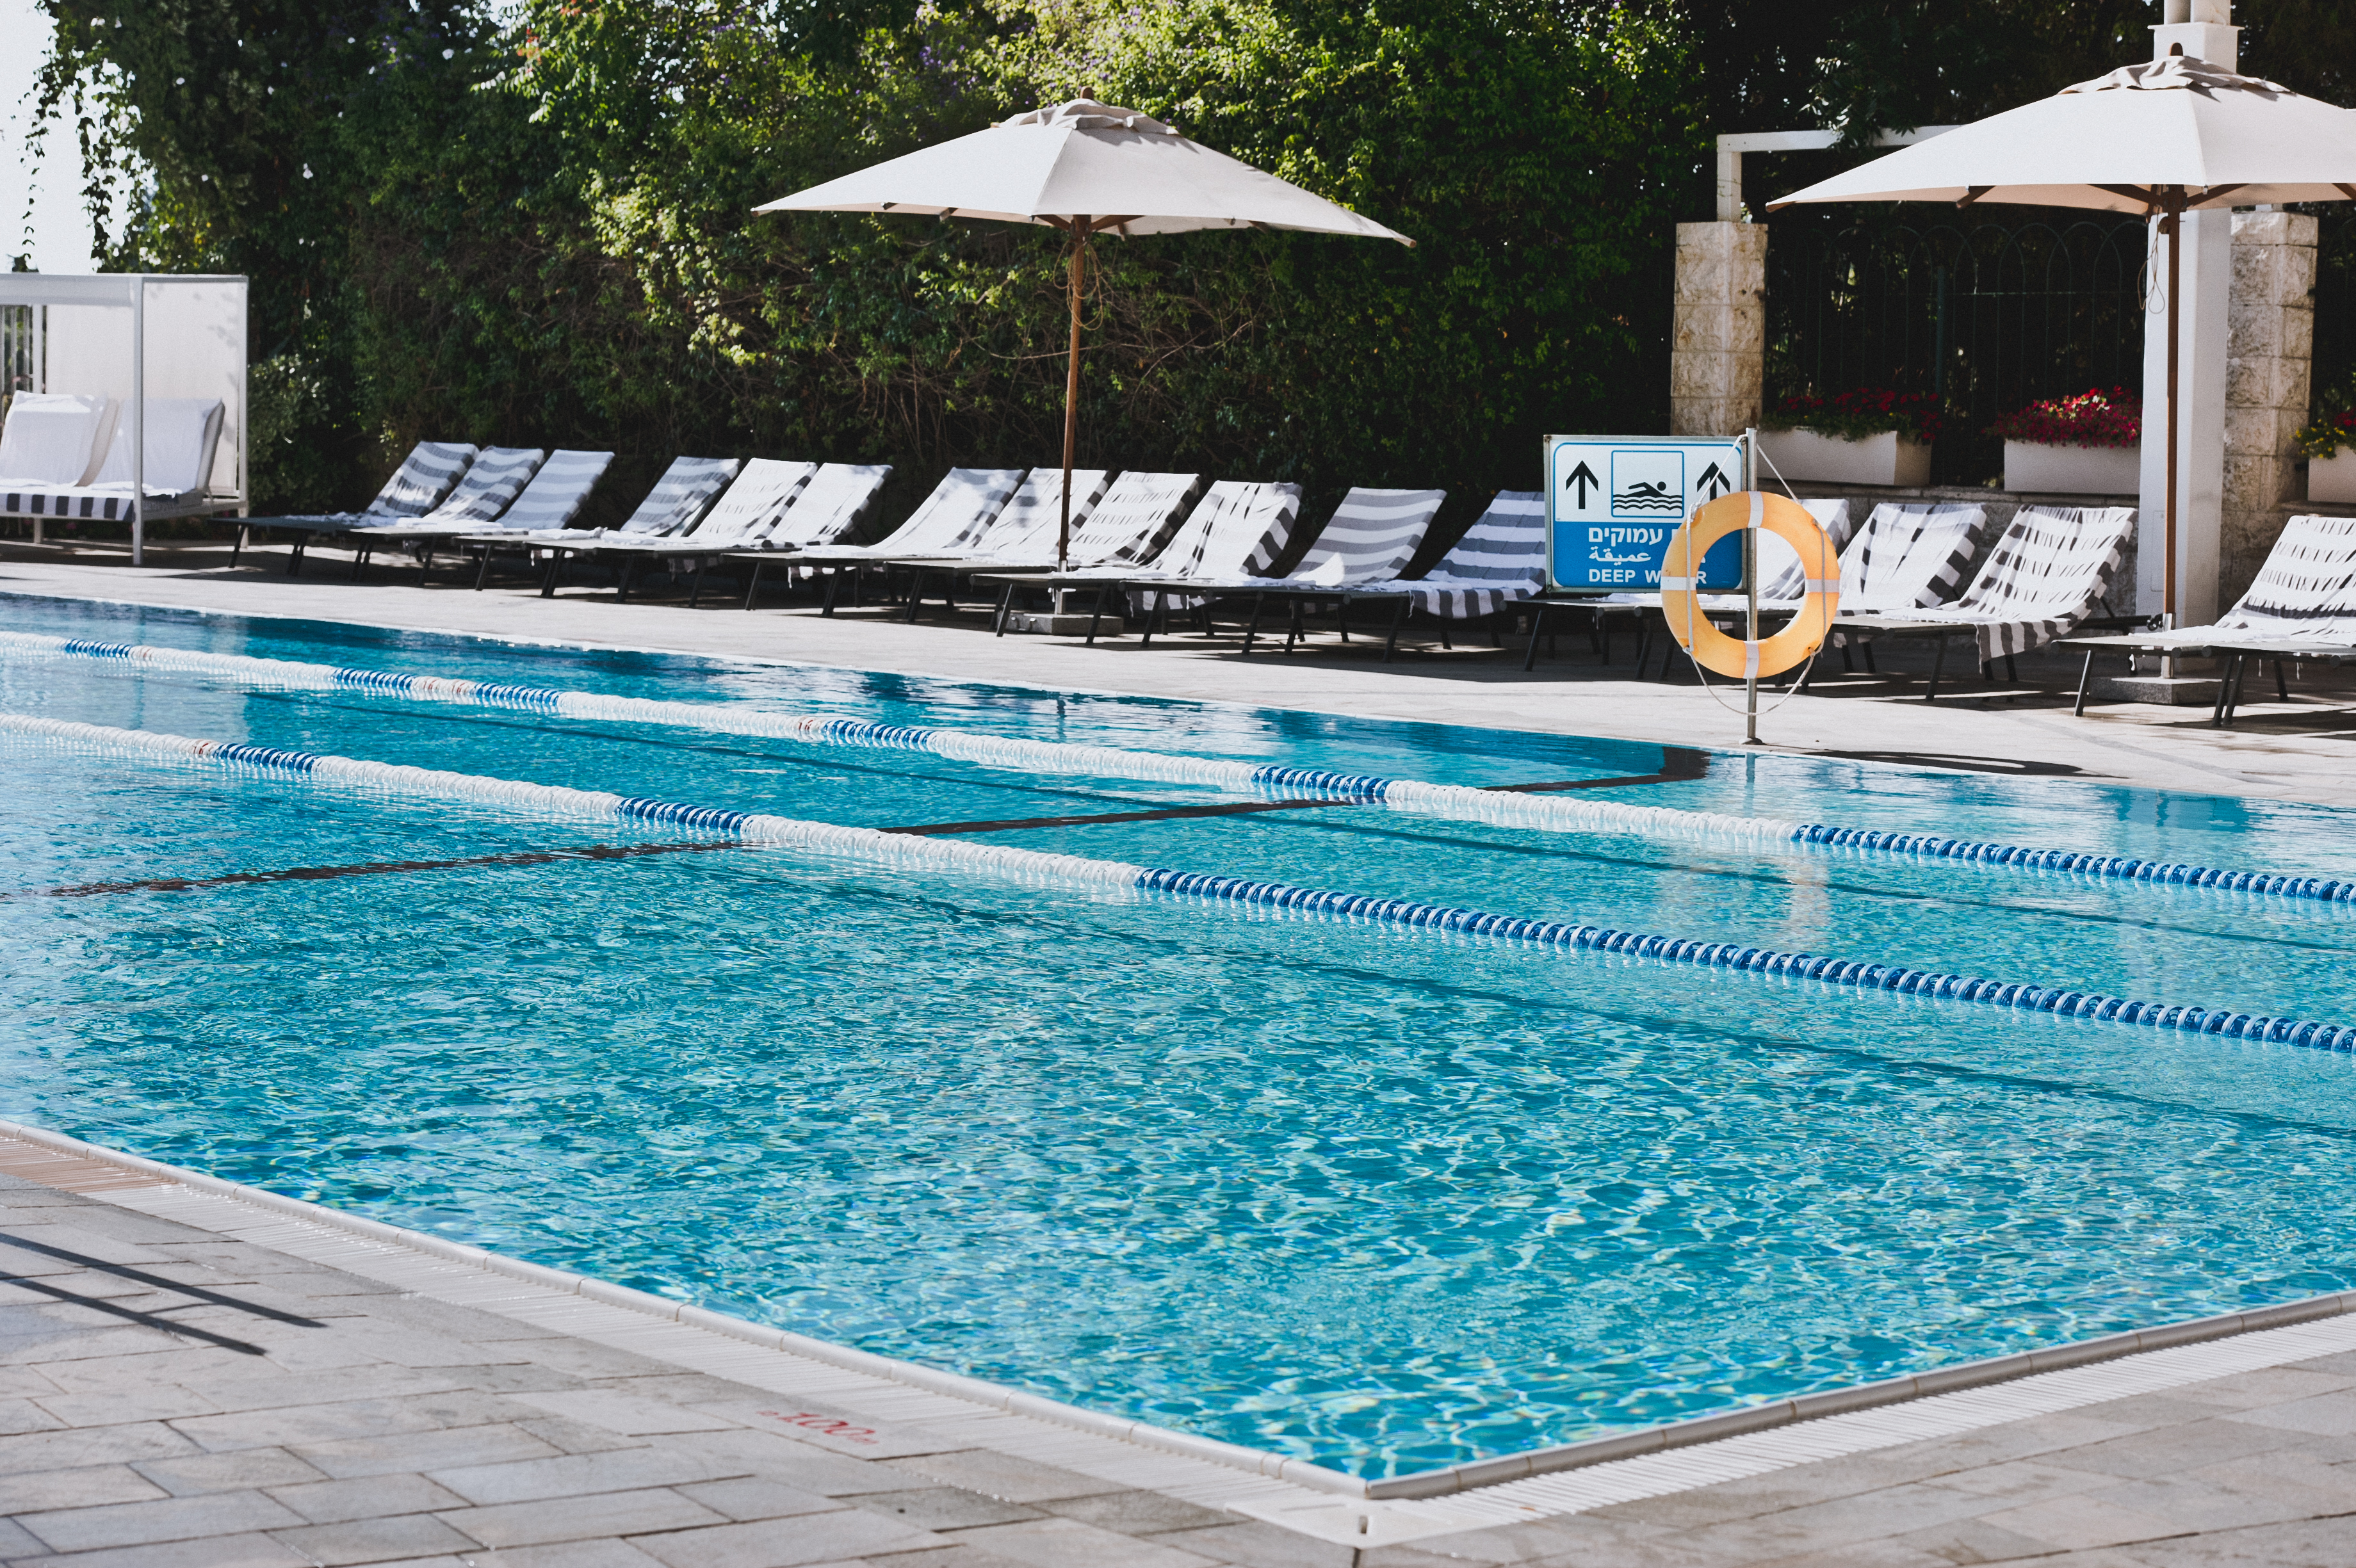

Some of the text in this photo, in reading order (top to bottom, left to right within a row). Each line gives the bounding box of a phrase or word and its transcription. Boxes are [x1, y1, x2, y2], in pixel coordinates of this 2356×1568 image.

[1588, 527, 1663, 547] עמוקים
[1588, 546, 1652, 566] عميقة
[1588, 569, 1636, 583] DEEP
